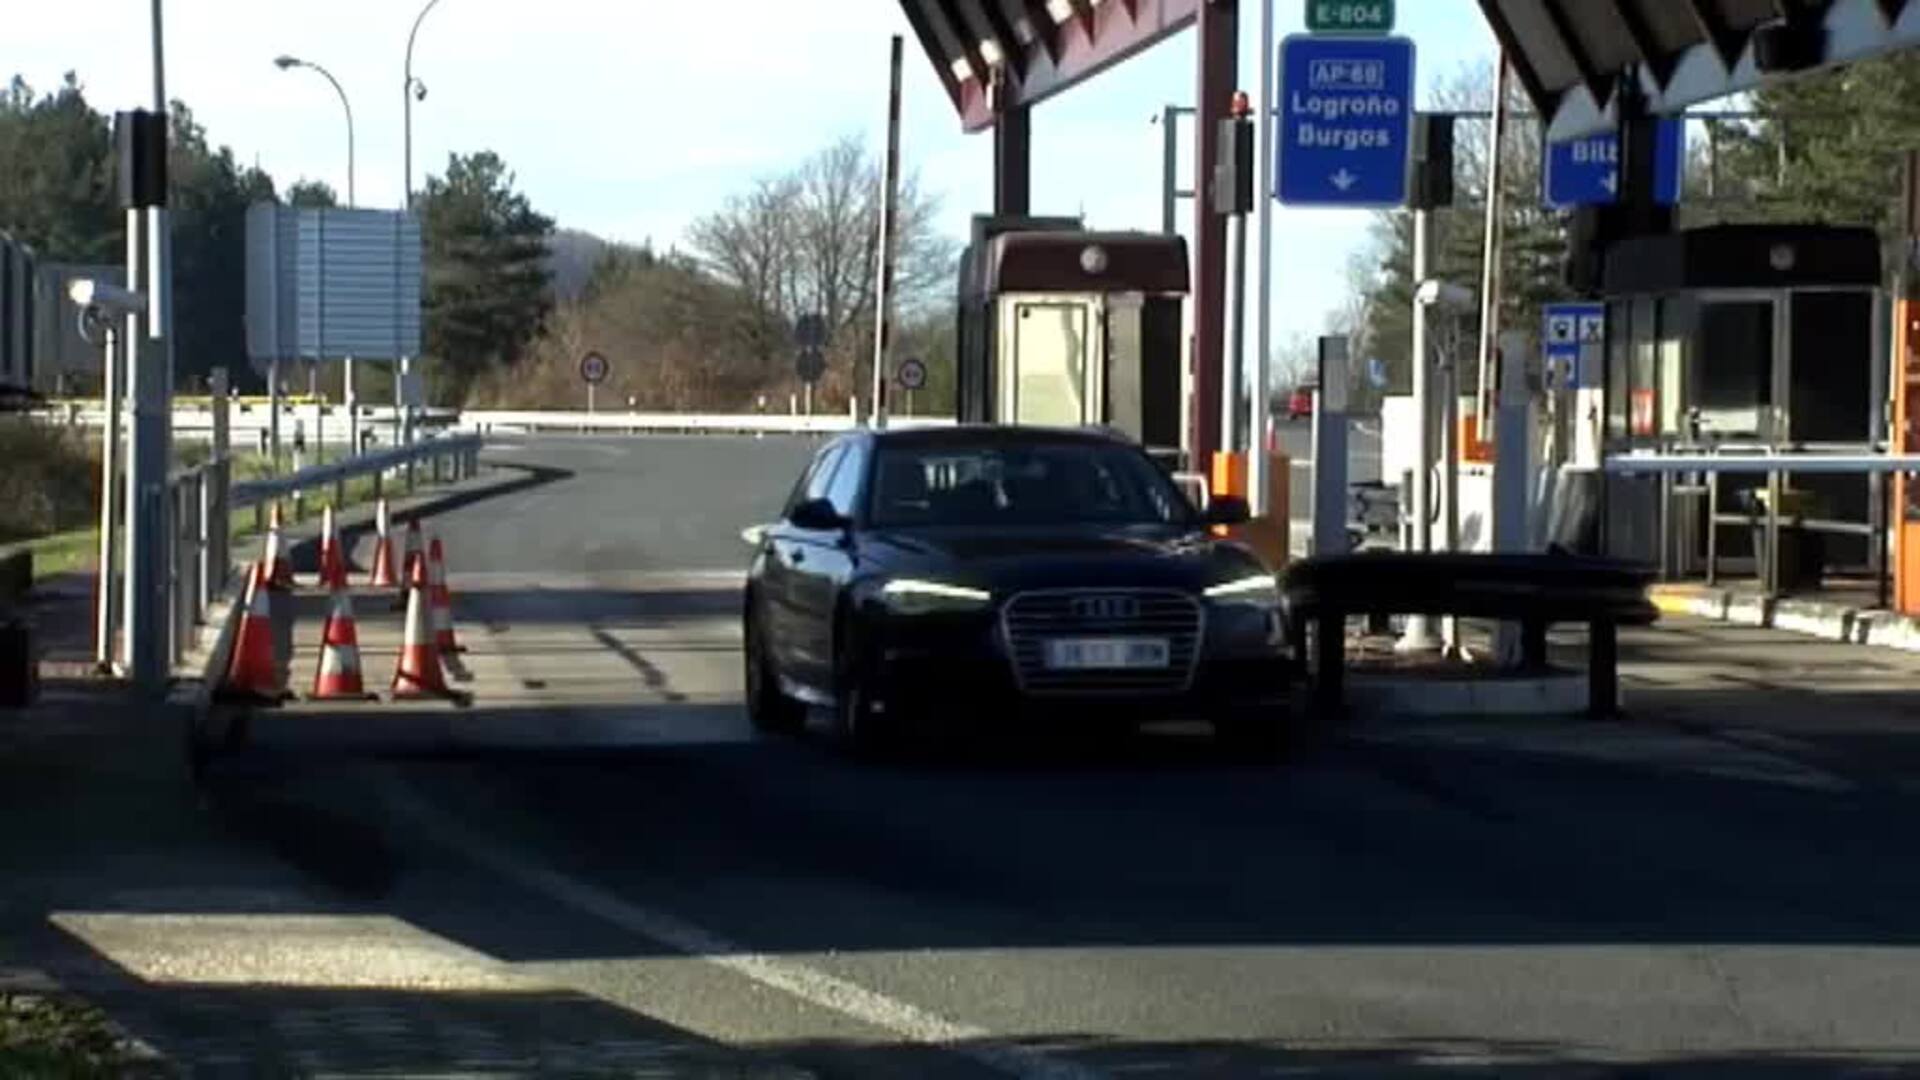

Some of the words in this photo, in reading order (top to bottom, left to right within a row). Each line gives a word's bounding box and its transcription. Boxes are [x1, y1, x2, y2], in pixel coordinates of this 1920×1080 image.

[1316, 4, 1382, 22] E-804
[1292, 90, 1399, 120] Logroño
[1298, 123, 1390, 150] Burgos
